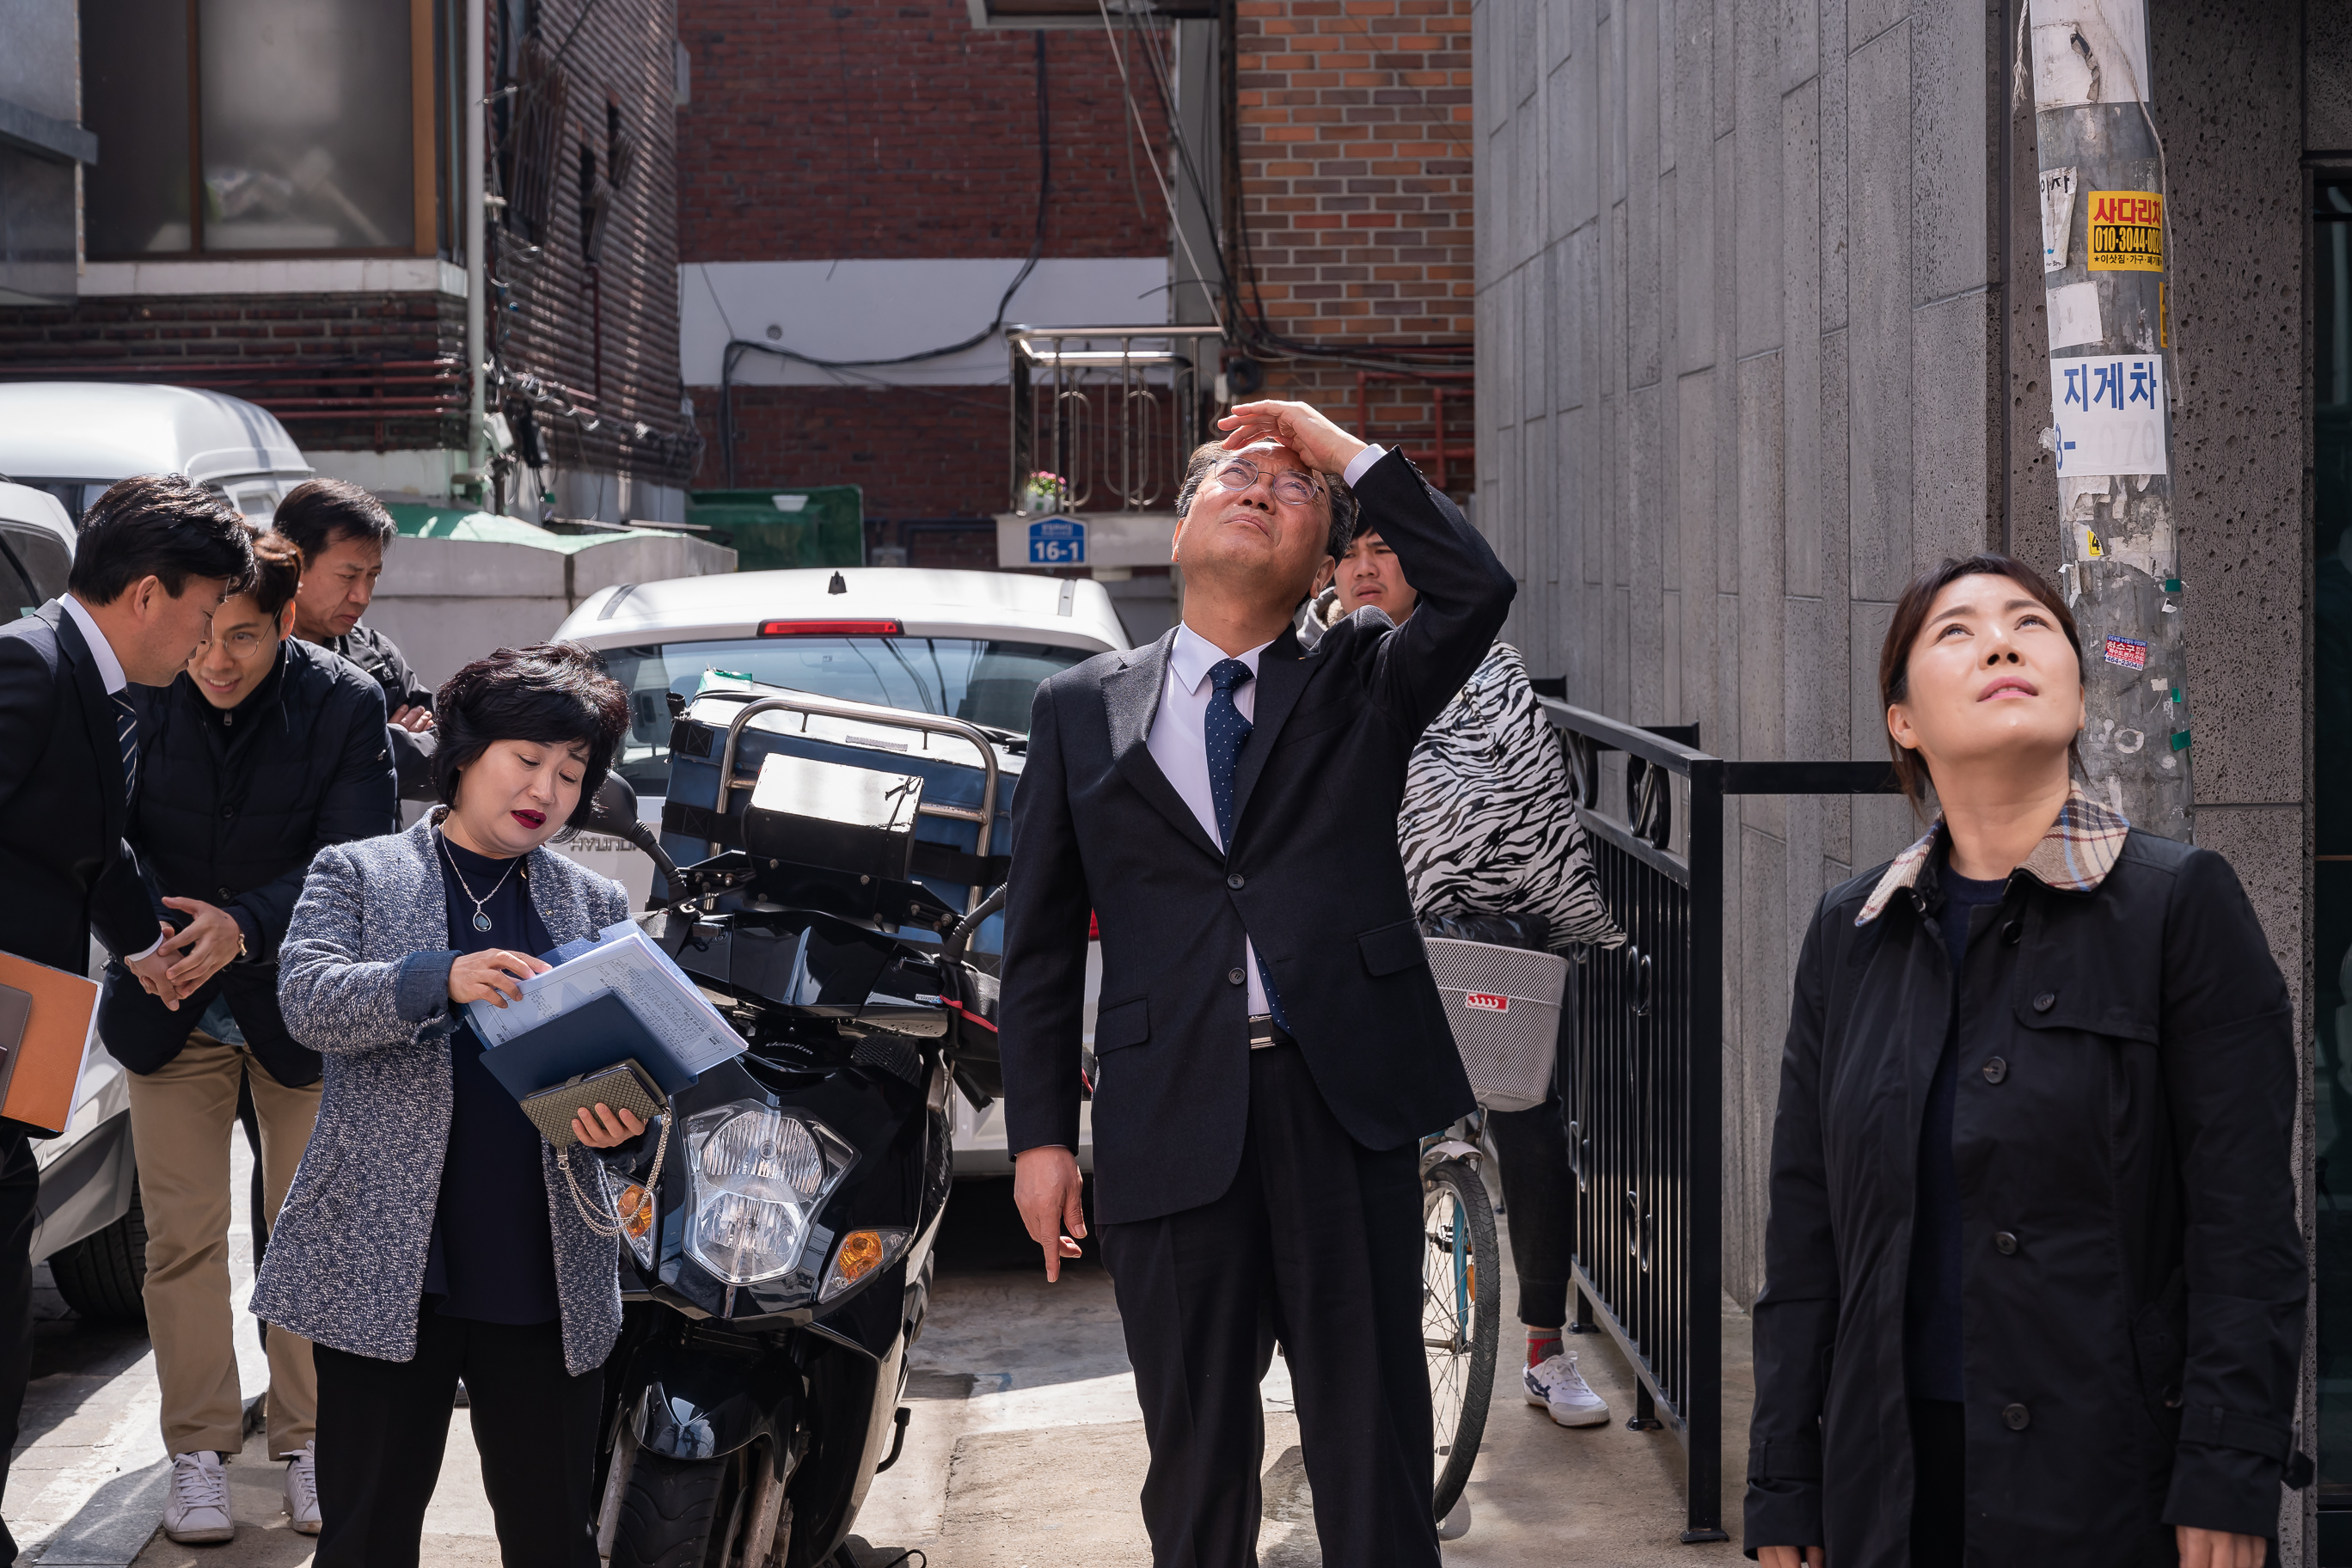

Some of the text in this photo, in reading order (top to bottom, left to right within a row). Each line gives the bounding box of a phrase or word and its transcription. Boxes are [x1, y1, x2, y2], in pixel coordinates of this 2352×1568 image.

[2093, 198, 2161, 227] 사다리차
[2064, 361, 2157, 412] 지게차
[1034, 541, 1079, 560] 16-1
[2106, 640, 2135, 652] 하수구
